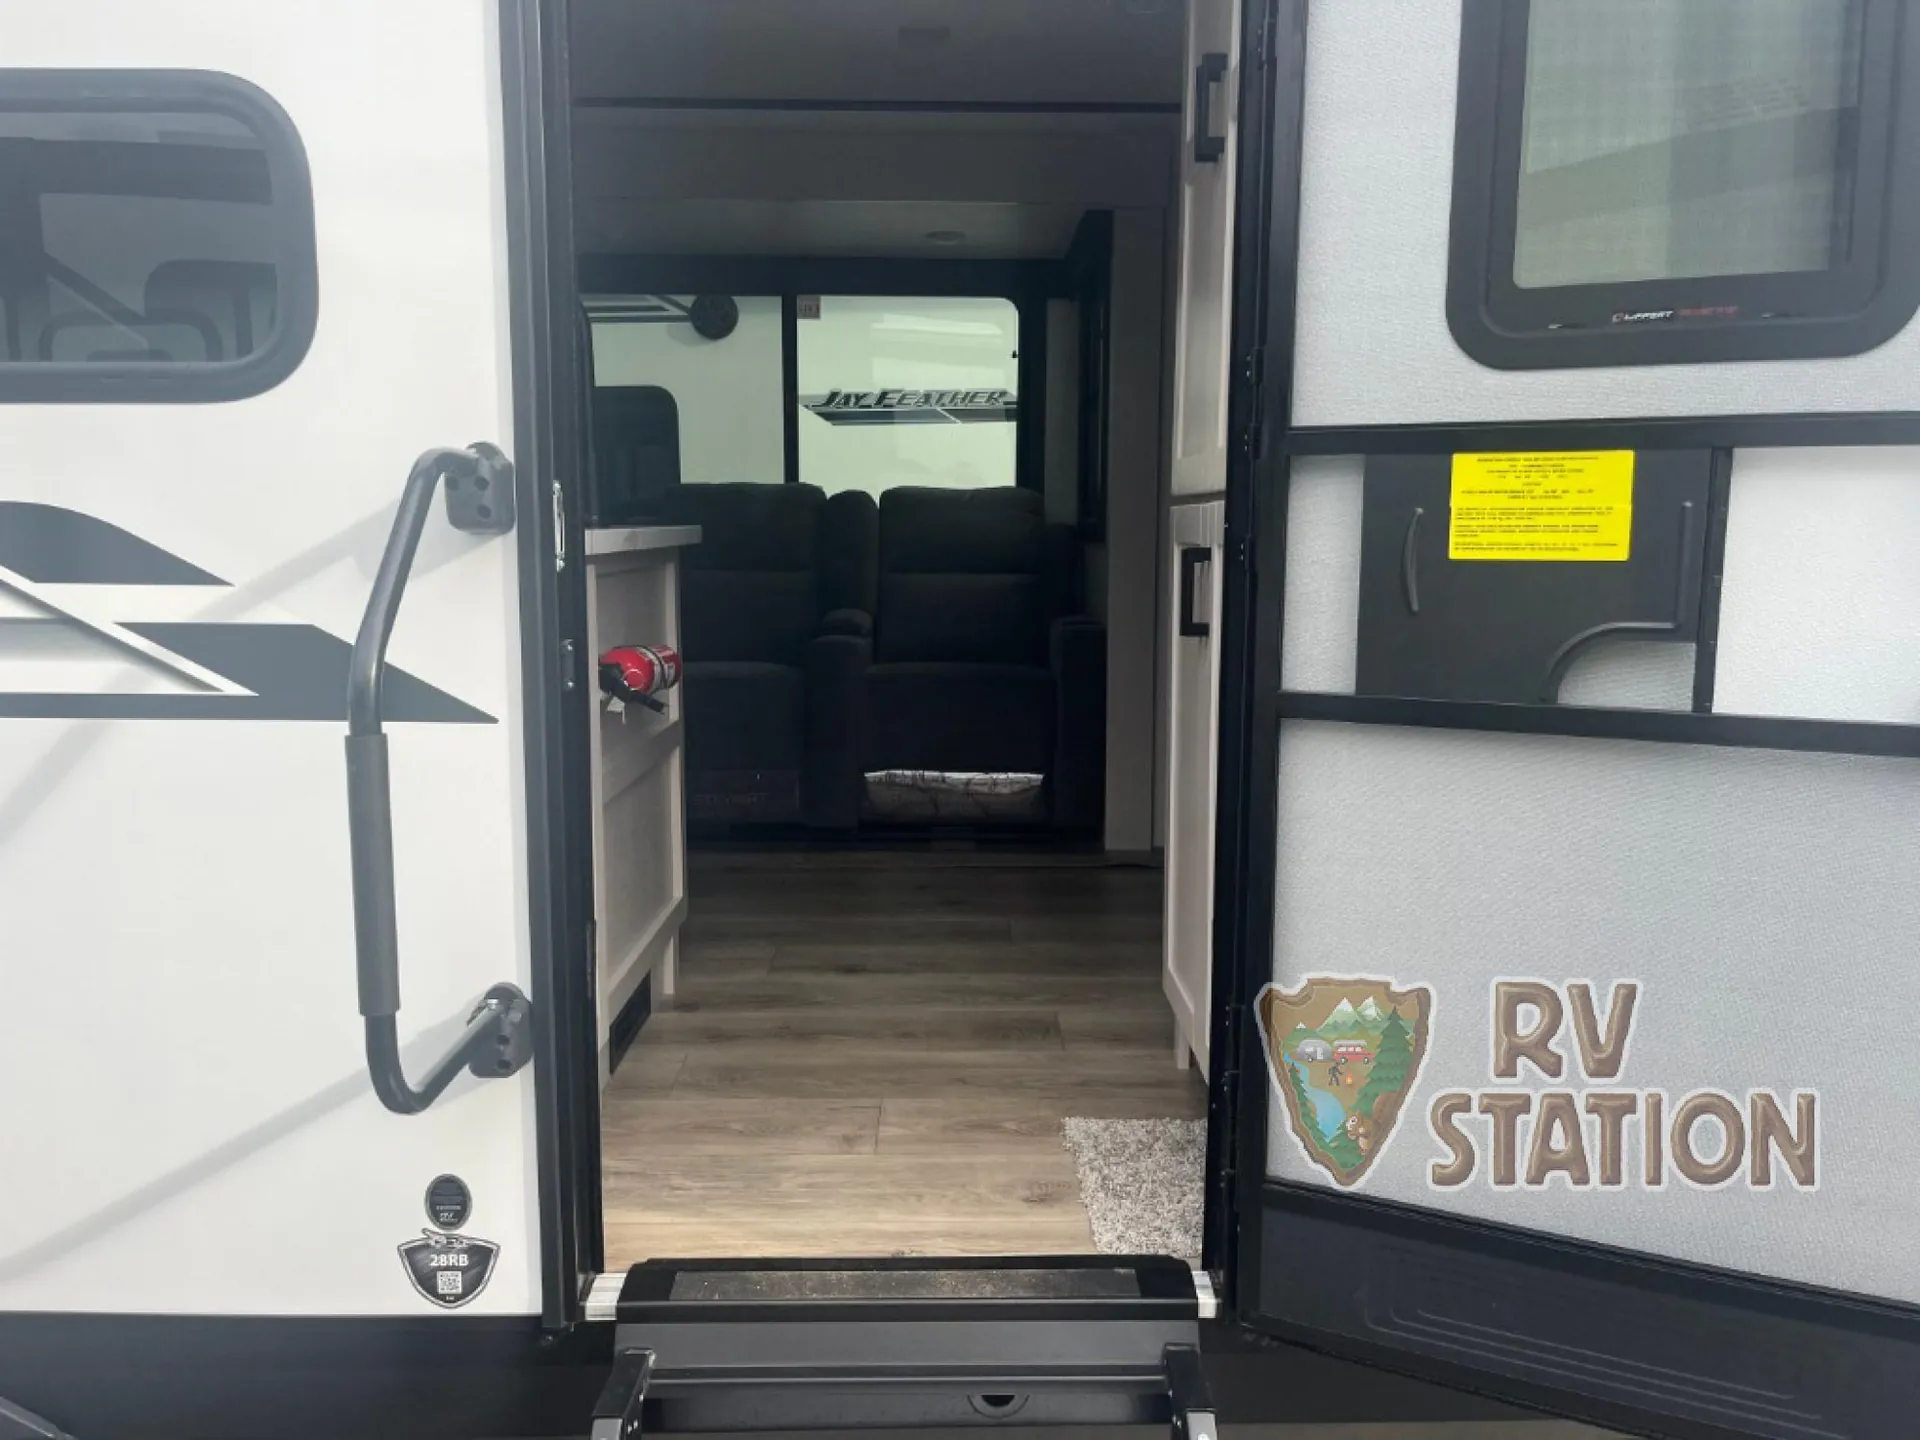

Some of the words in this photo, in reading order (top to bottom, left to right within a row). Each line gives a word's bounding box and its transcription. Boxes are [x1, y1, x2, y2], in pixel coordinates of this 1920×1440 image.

[821, 388, 872, 408] JAY
[873, 388, 1008, 407] FEATHER
[428, 1253, 469, 1267] 28RB
